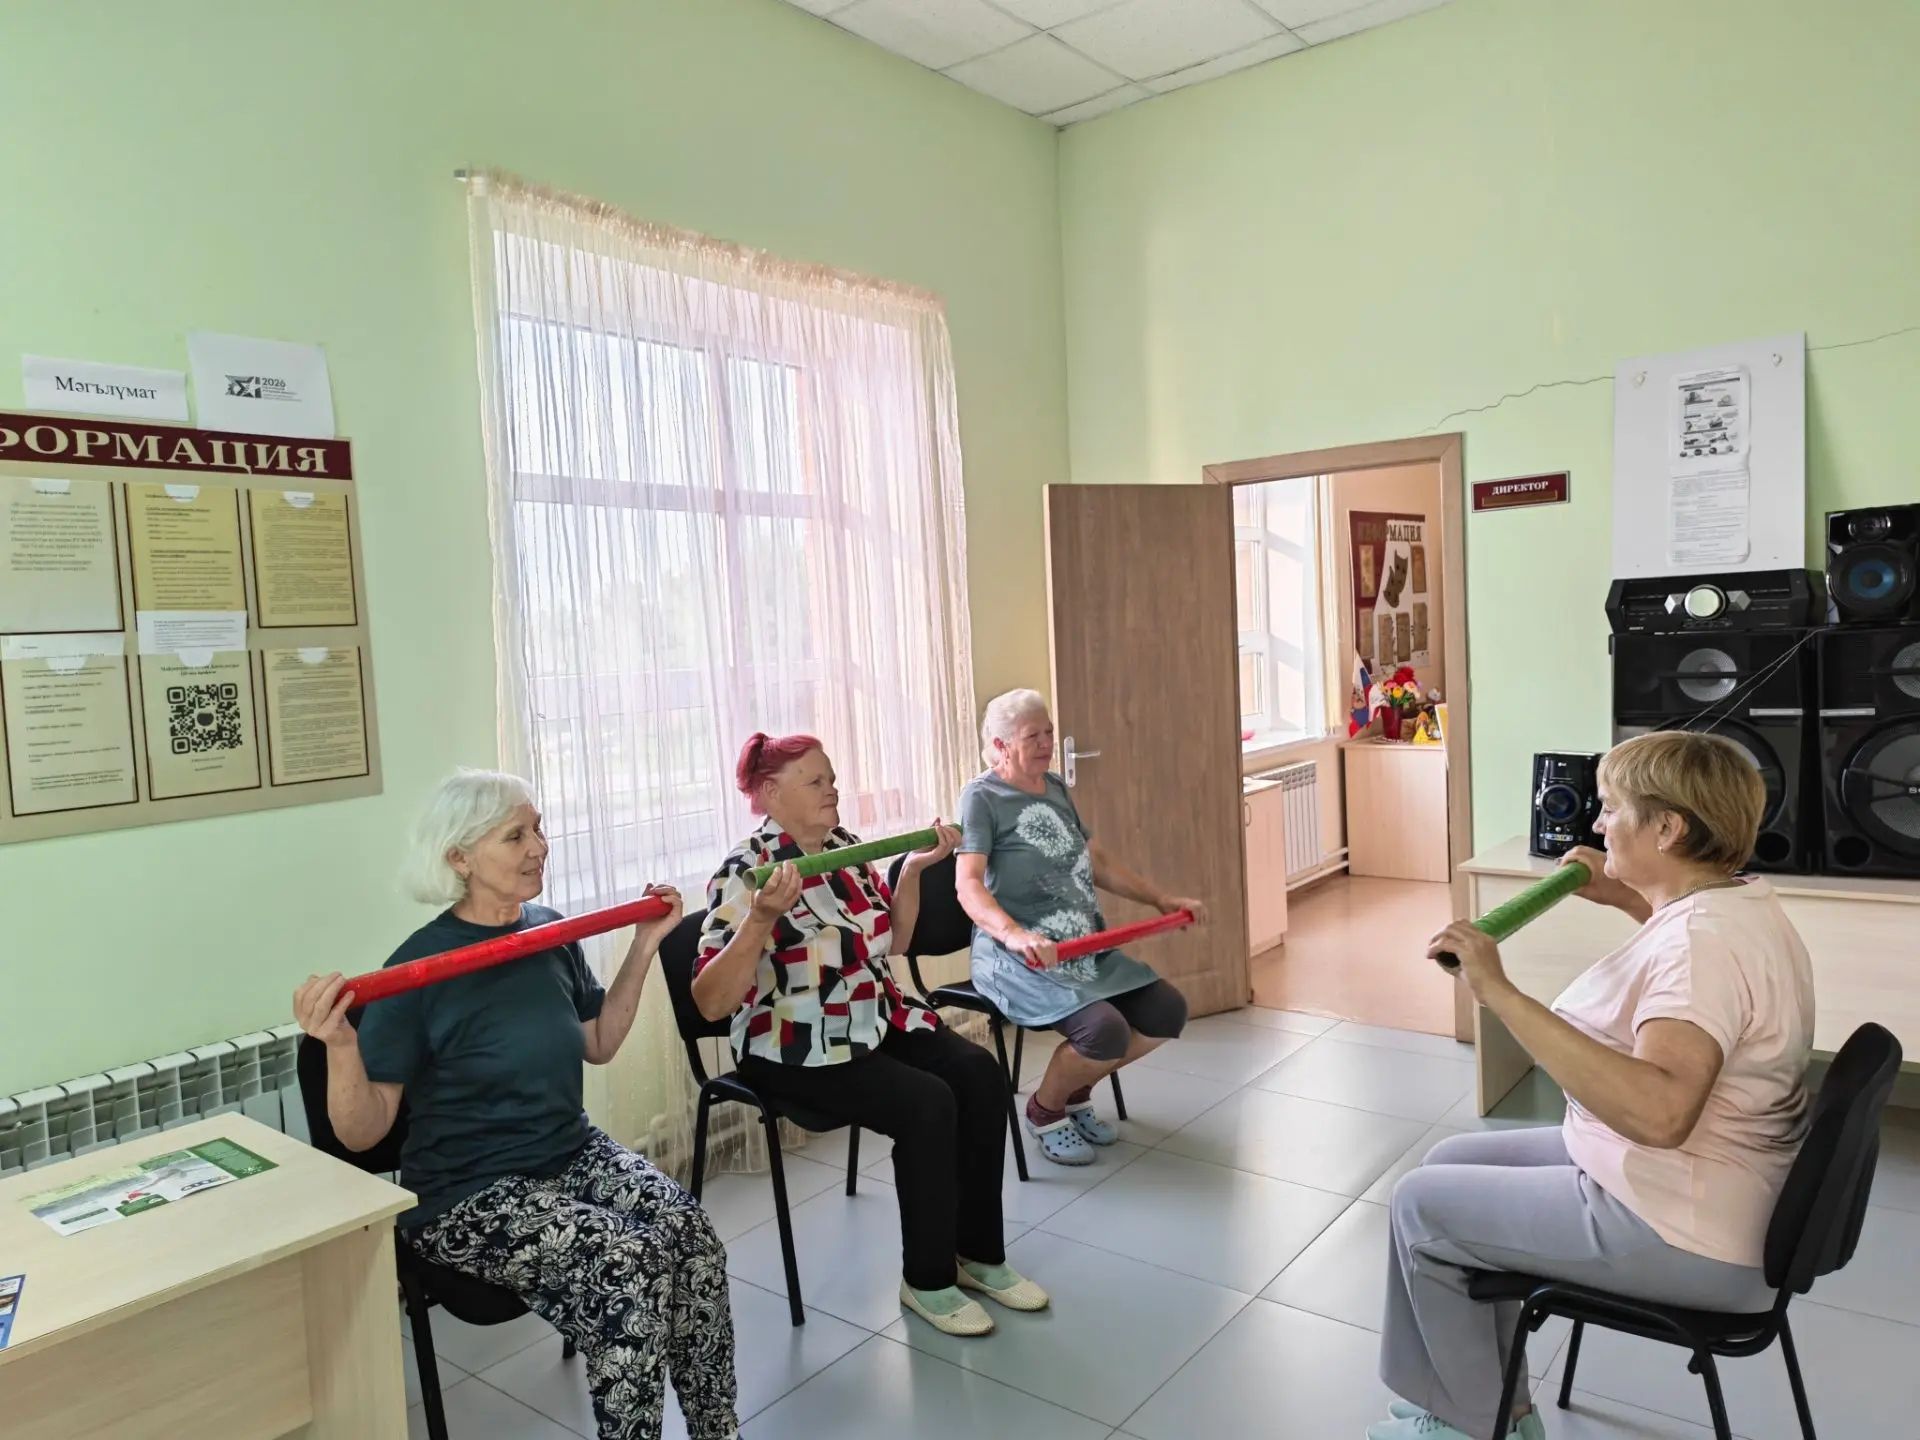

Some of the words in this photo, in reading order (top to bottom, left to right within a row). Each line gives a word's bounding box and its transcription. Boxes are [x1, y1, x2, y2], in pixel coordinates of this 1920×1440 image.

[54, 375, 157, 400] Мәгълүмат
[261, 377, 286, 388] 2026
[1491, 480, 1549, 496] ДИРЕКТОР
